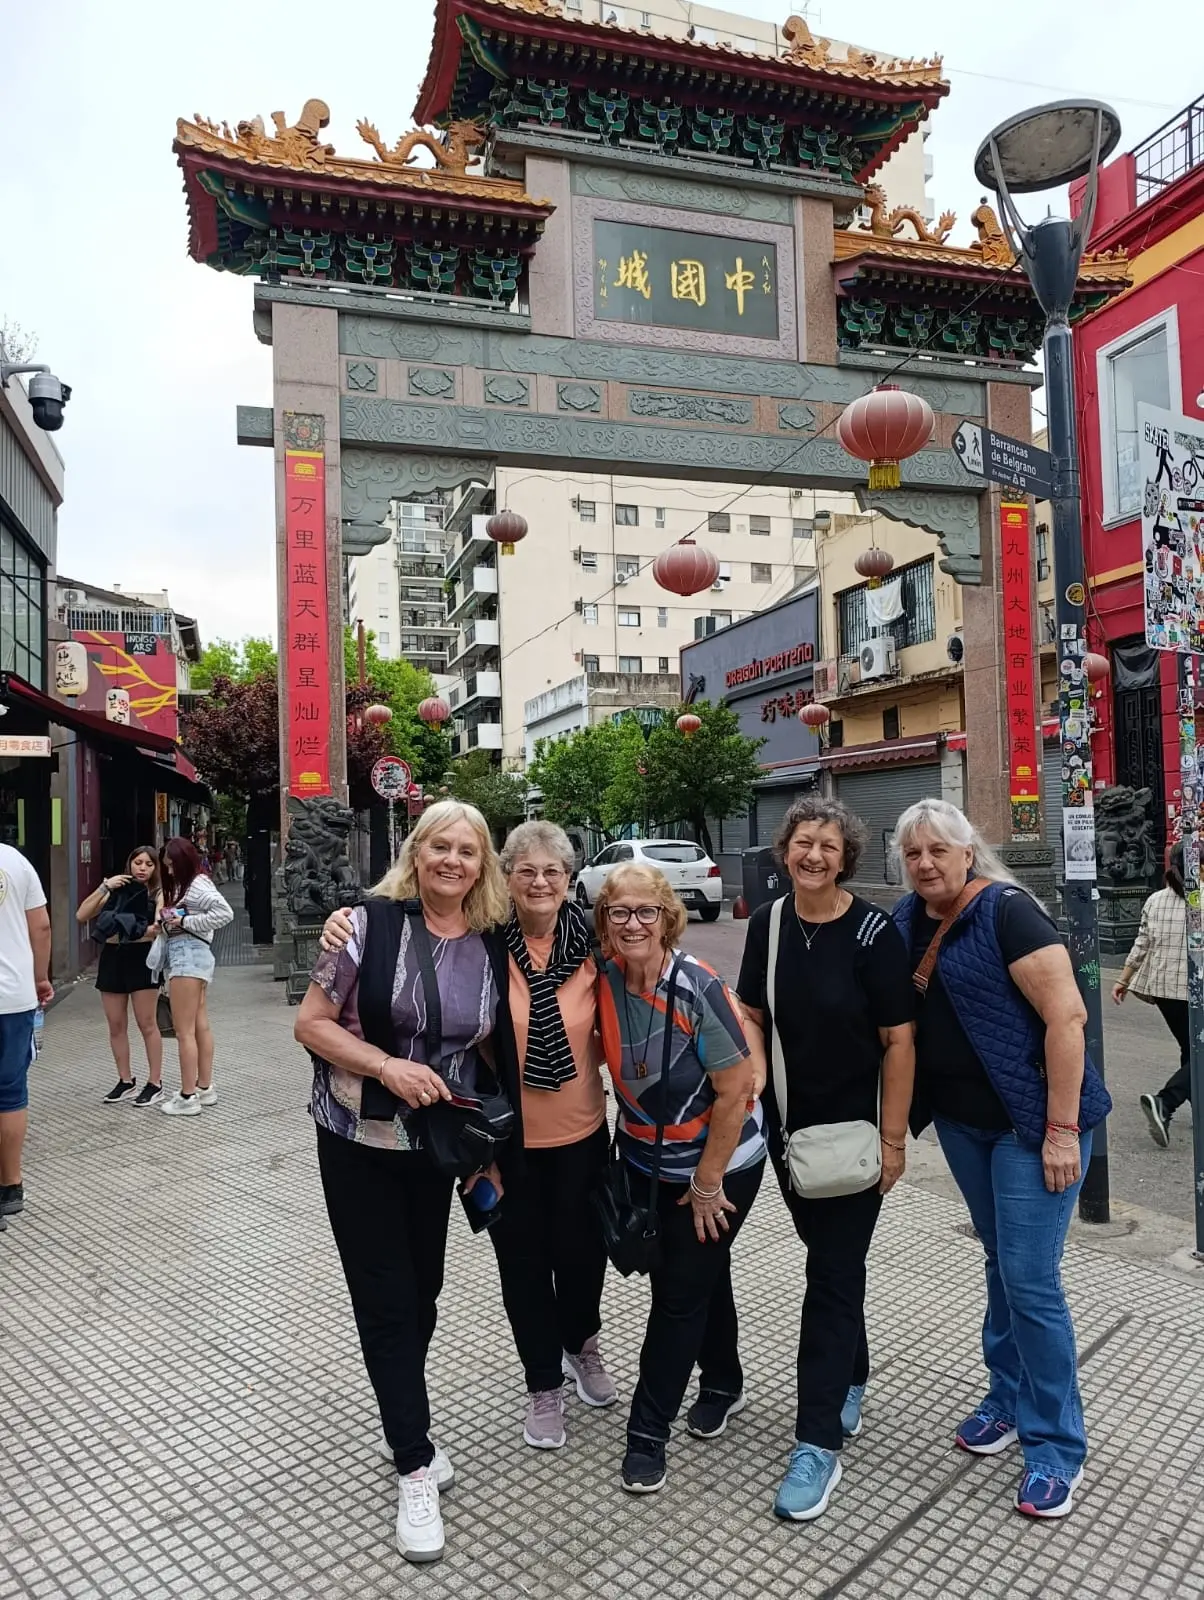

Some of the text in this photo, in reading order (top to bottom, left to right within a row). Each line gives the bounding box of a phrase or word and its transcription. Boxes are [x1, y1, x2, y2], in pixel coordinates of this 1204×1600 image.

[614, 249, 756, 316] 中國城
[990, 433, 1029, 459] Barrancas
[991, 449, 1001, 463] de
[1003, 452, 1037, 476] Belgrano
[133, 643, 153, 652] ARS
[291, 496, 322, 757] 万里蓝天群星灿烂
[1006, 539, 1031, 754] 九州大地百业繁荣
